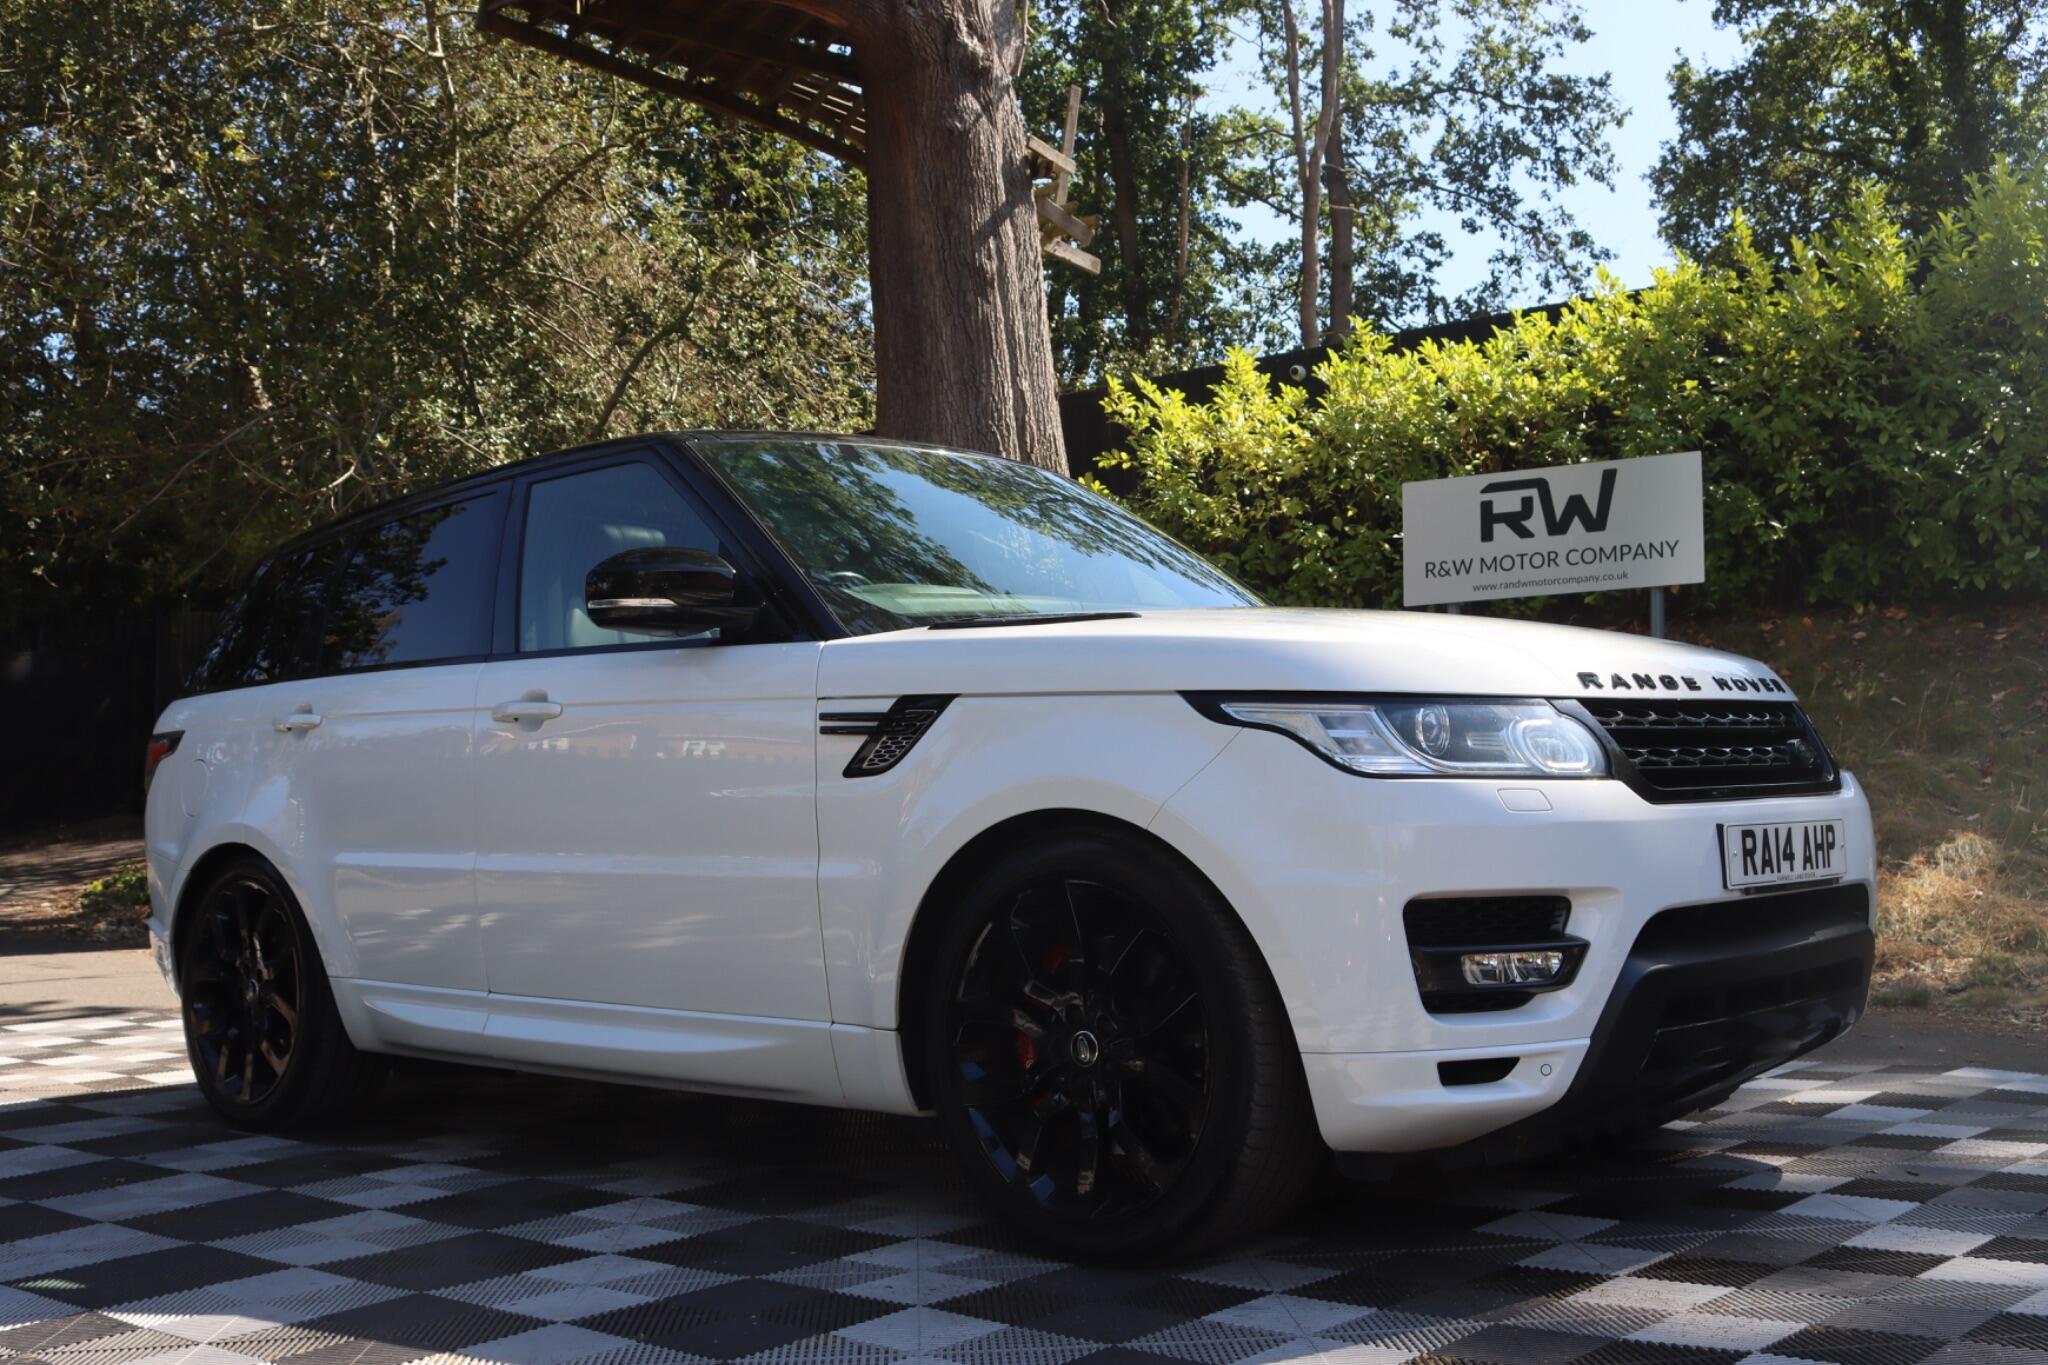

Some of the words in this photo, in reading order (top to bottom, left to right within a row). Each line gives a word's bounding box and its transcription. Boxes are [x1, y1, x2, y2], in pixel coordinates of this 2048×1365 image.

[1480, 468, 1618, 543] RW
[1424, 557, 1474, 579] R&W
[1479, 550, 1560, 574] MOTOR
[1565, 539, 1680, 567] COMPANY
[1472, 570, 1629, 592] www.randwmotorcompany.co.uk
[1576, 671, 1702, 692] RANGE
[1712, 675, 1787, 694] ROVER
[1741, 827, 1796, 877] RA14
[1803, 823, 1836, 872] AHP
